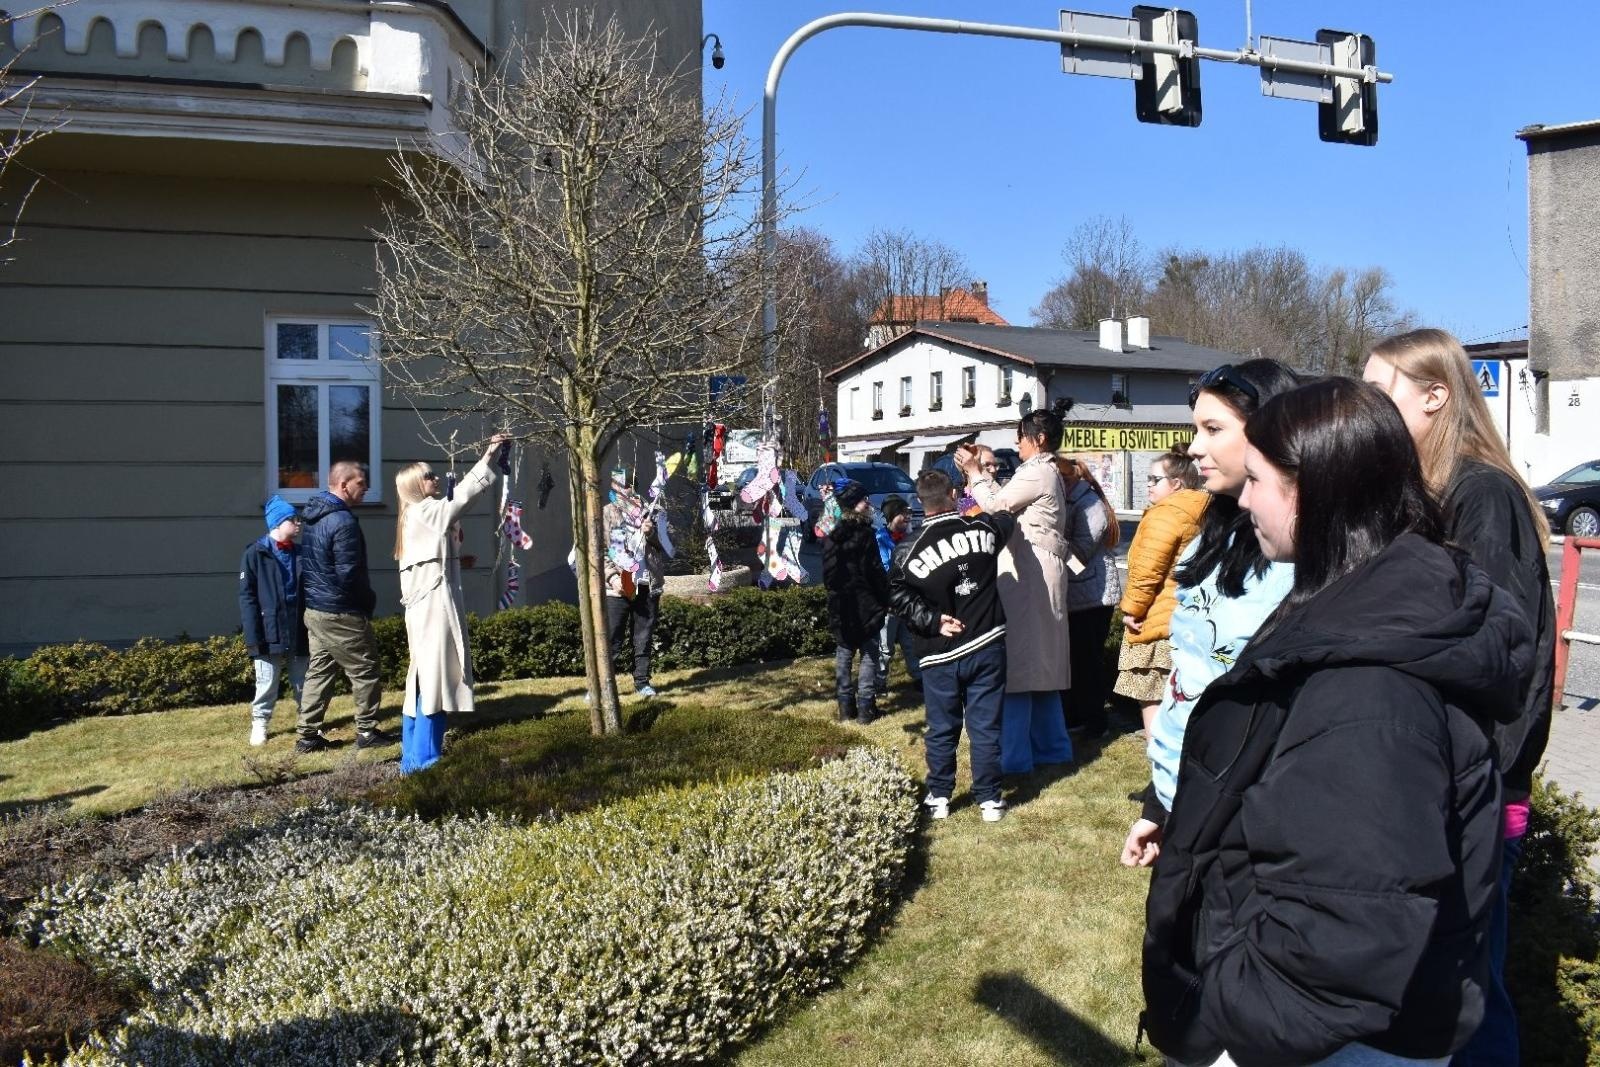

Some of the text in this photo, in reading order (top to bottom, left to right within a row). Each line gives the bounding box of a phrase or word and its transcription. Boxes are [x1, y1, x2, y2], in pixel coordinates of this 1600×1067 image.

[1568, 397, 1581, 407] 28
[1064, 429, 1107, 448] MEBLE
[908, 529, 996, 579] CHAOTIC
